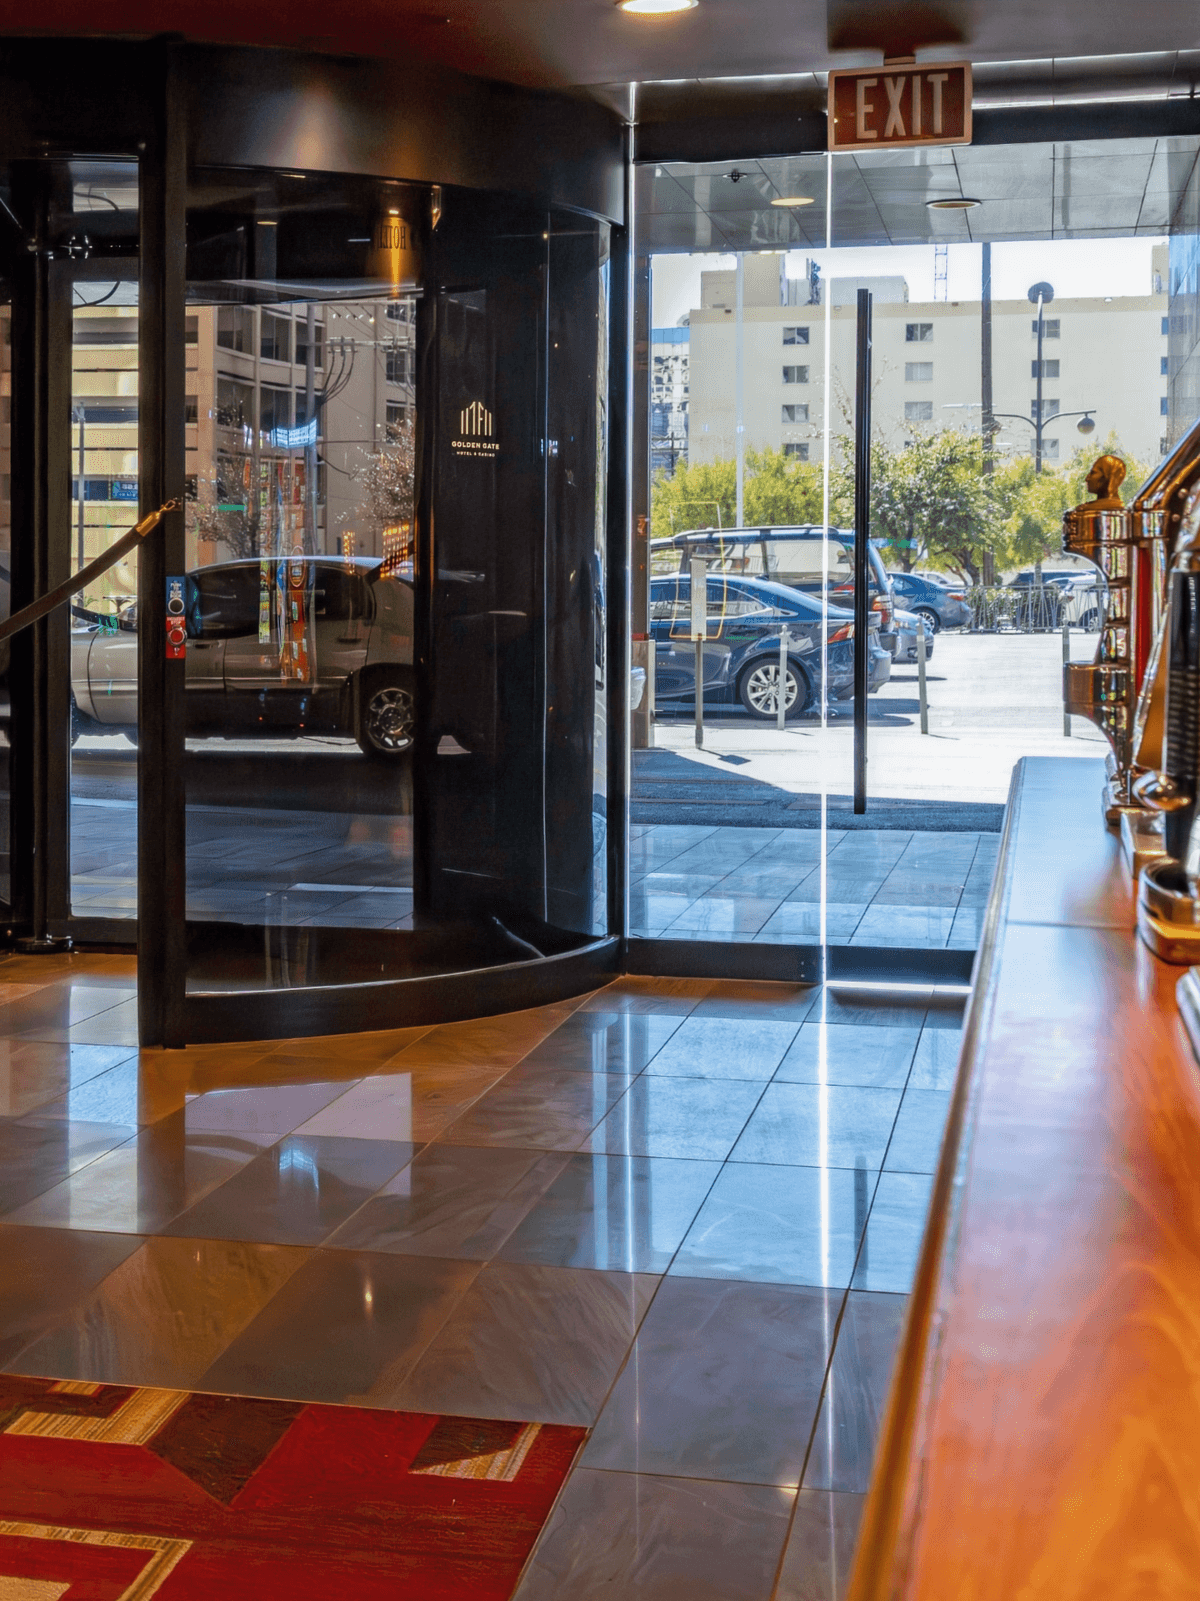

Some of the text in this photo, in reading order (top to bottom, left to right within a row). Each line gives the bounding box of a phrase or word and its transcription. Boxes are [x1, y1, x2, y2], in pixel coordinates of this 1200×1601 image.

[856, 73, 949, 139] EXIT
[451, 441, 500, 450] GOLDEN GATE
